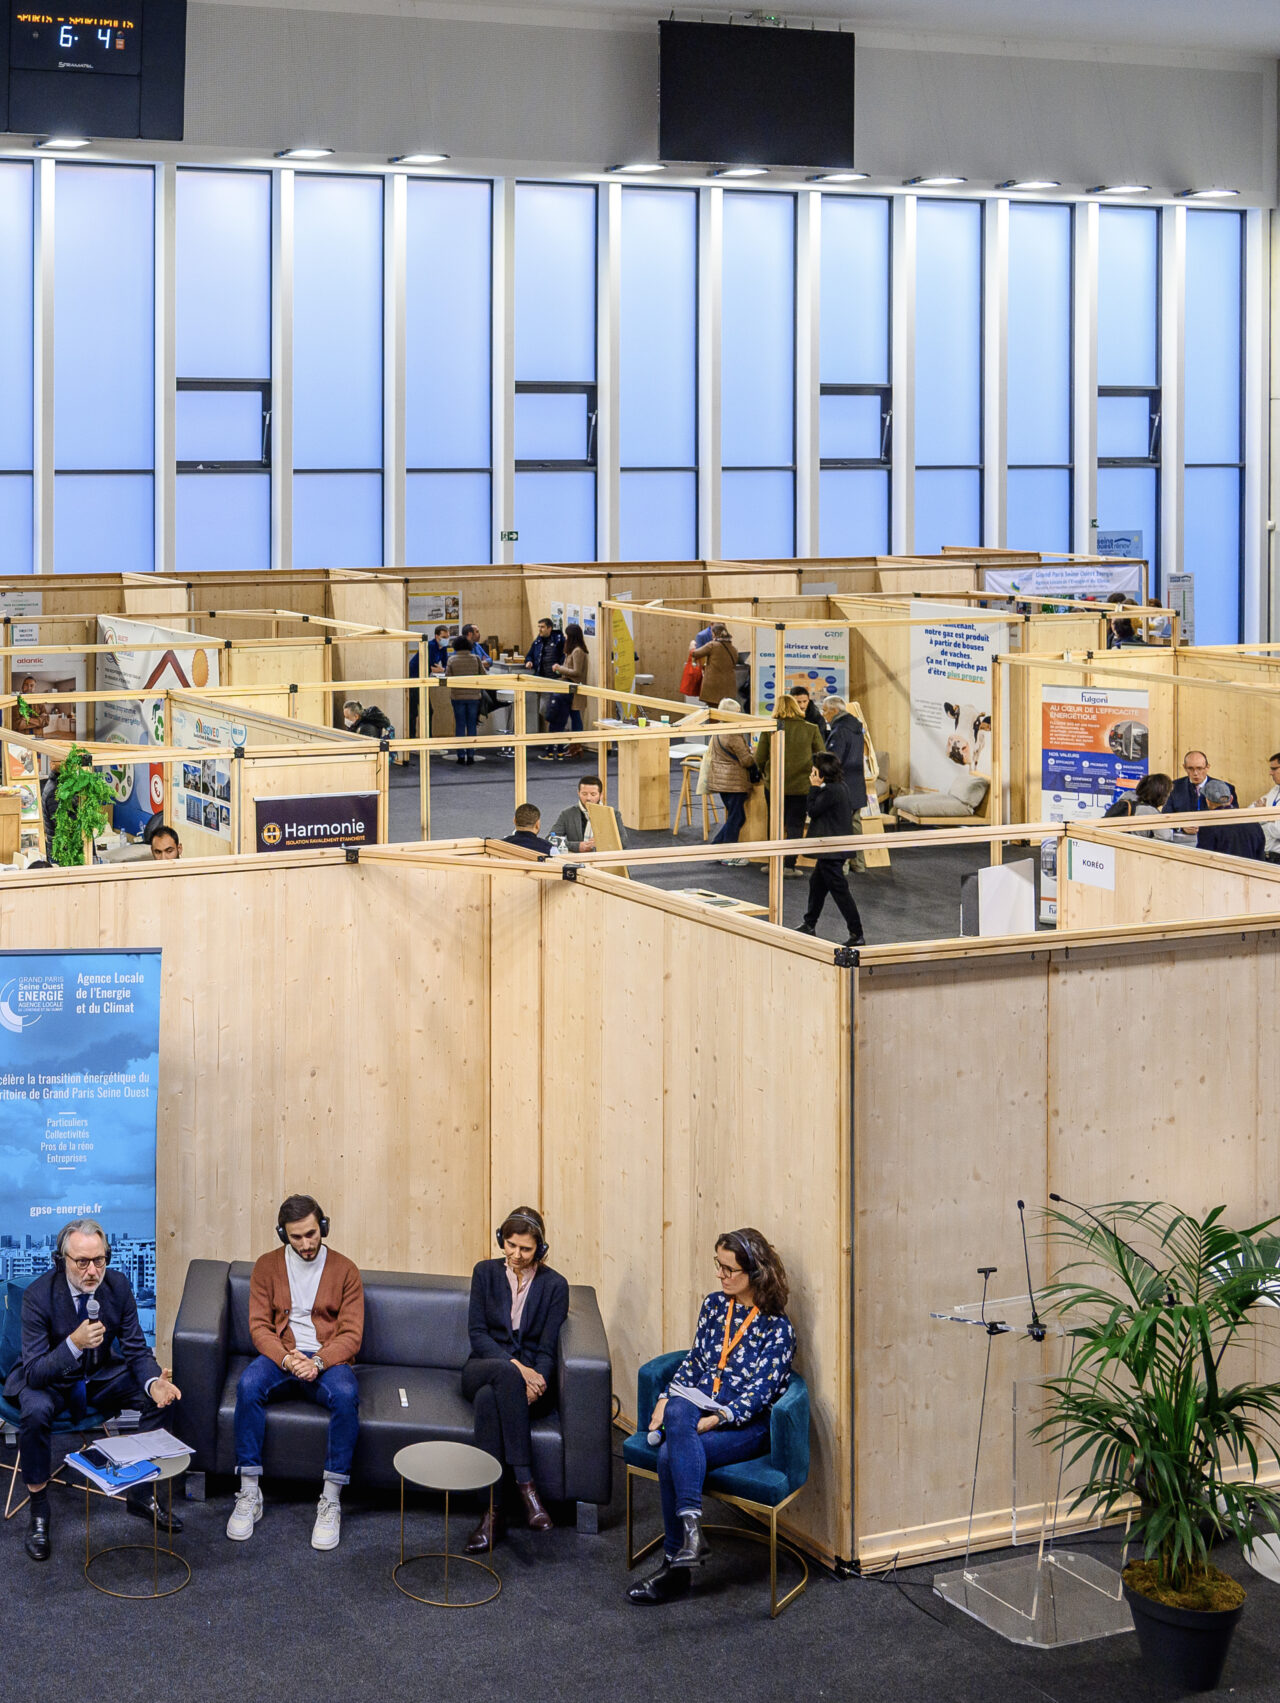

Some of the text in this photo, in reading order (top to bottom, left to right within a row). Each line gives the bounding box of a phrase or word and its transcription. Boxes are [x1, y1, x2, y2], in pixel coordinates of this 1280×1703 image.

[924, 628, 941, 636] notre
[942, 630, 954, 639] gaz
[966, 633, 989, 642] produit
[934, 639, 952, 647] partir
[962, 642, 984, 651] bouses
[926, 656, 934, 665] Ça
[943, 658, 975, 670] l'empêche
[976, 664, 987, 672] pas
[928, 667, 946, 676] d'être
[947, 670, 960, 679] plus
[1081, 691, 1108, 704] Fulgoni
[285, 818, 365, 838] Harmonie
[1082, 859, 1104, 870] KORÉO
[44, 975, 64, 983] PARIS
[77, 971, 145, 986] Agence Locale
[42, 982, 64, 990] Ouest
[18, 990, 64, 1001] ENERGIE
[76, 987, 131, 1000] de l'Energie
[76, 1002, 135, 1013] et du Climat
[27, 1073, 36, 1085] la
[38, 1073, 81, 1085] transition
[83, 1072, 136, 1086] énergétique
[138, 1072, 150, 1083] du
[29, 1088, 40, 1100] de
[42, 1088, 70, 1099] Grand
[72, 1087, 94, 1099] Paris
[97, 1087, 121, 1098] Seine
[123, 1086, 149, 1098] Ouest
[47, 1118, 88, 1127] Particuliers
[45, 1129, 90, 1139] Collectivités
[40, 1141, 94, 1151] Pros de la réno
[47, 1153, 87, 1164] Entreprises
[30, 1203, 103, 1217] gpso-energie.fr
